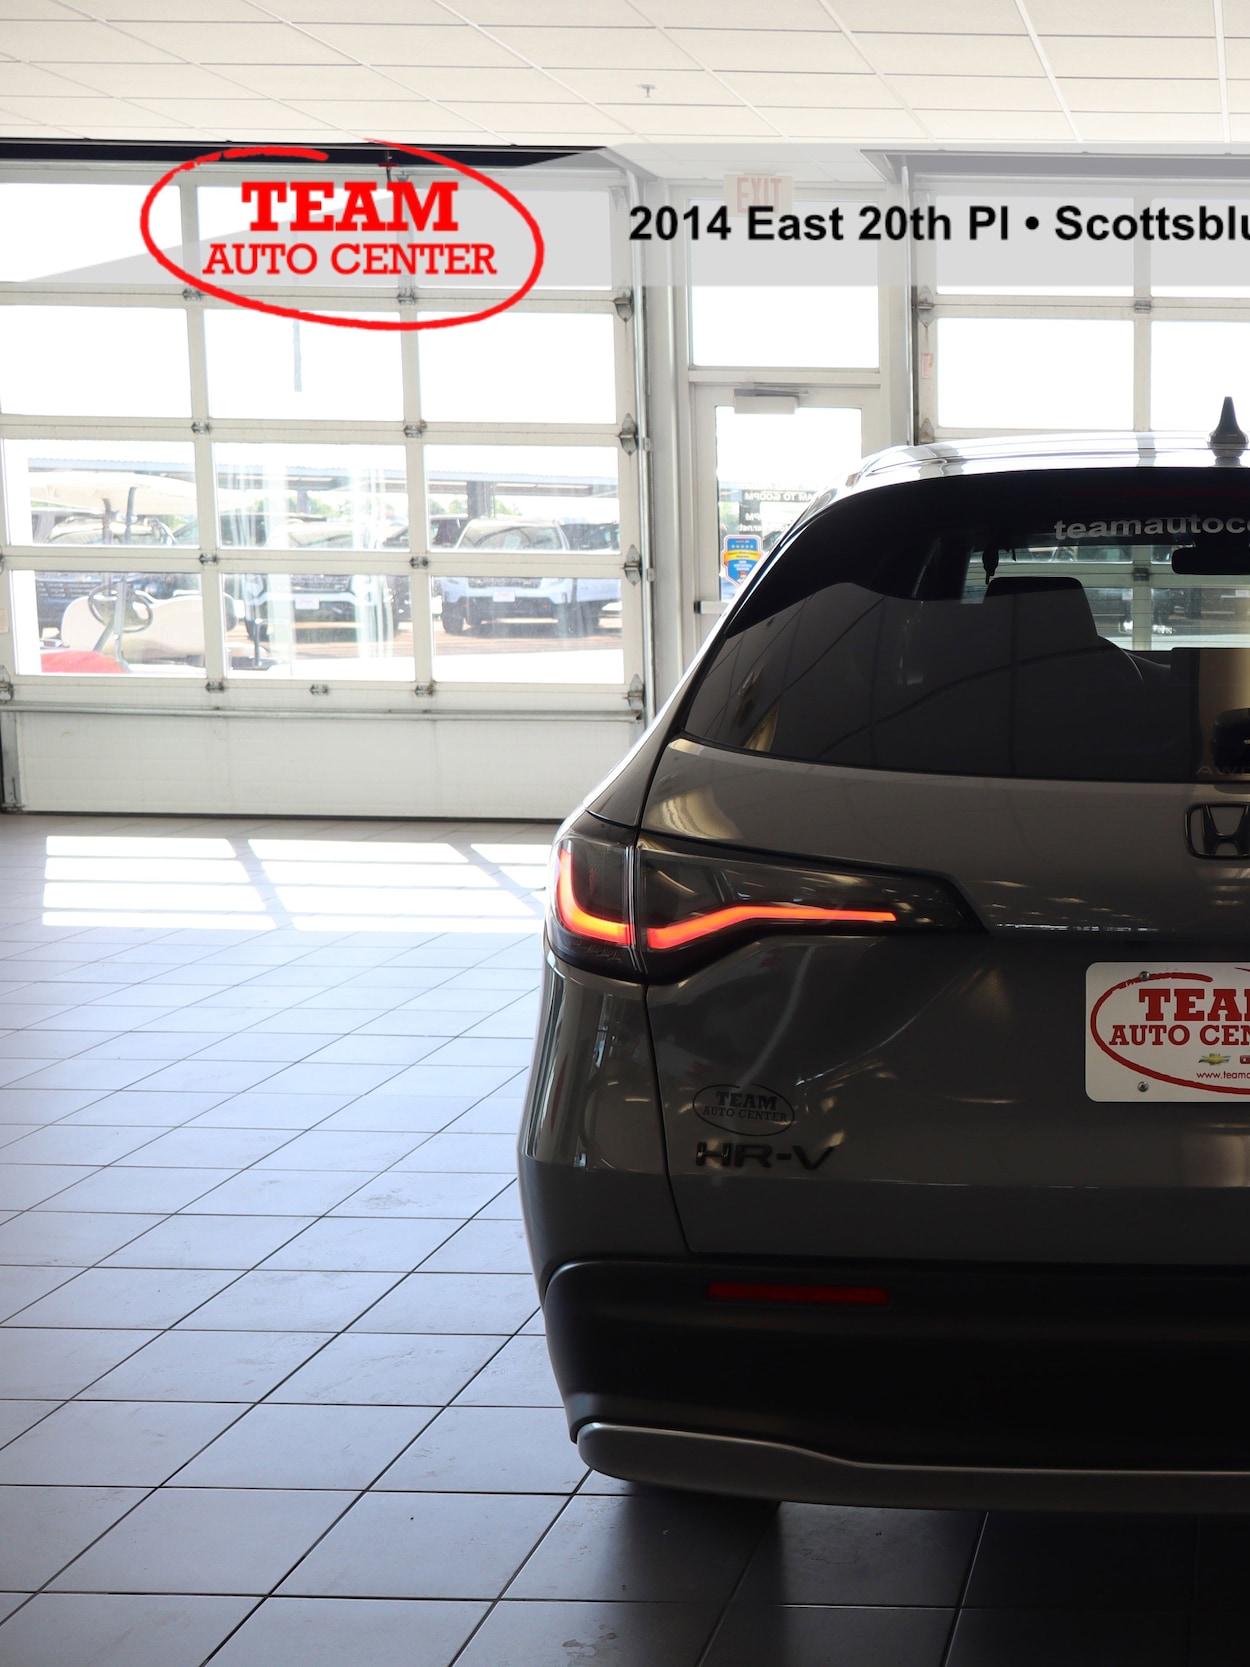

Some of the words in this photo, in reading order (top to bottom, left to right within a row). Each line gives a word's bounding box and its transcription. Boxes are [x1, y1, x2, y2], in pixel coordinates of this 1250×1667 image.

[736, 177, 782, 215] EXIT
[1109, 1024, 1190, 1046] AUTO
[715, 1091, 778, 1111] TEAM
[702, 1106, 735, 1118] AUTO
[738, 1108, 788, 1123] CENTER
[695, 1142, 835, 1171] HR-V
